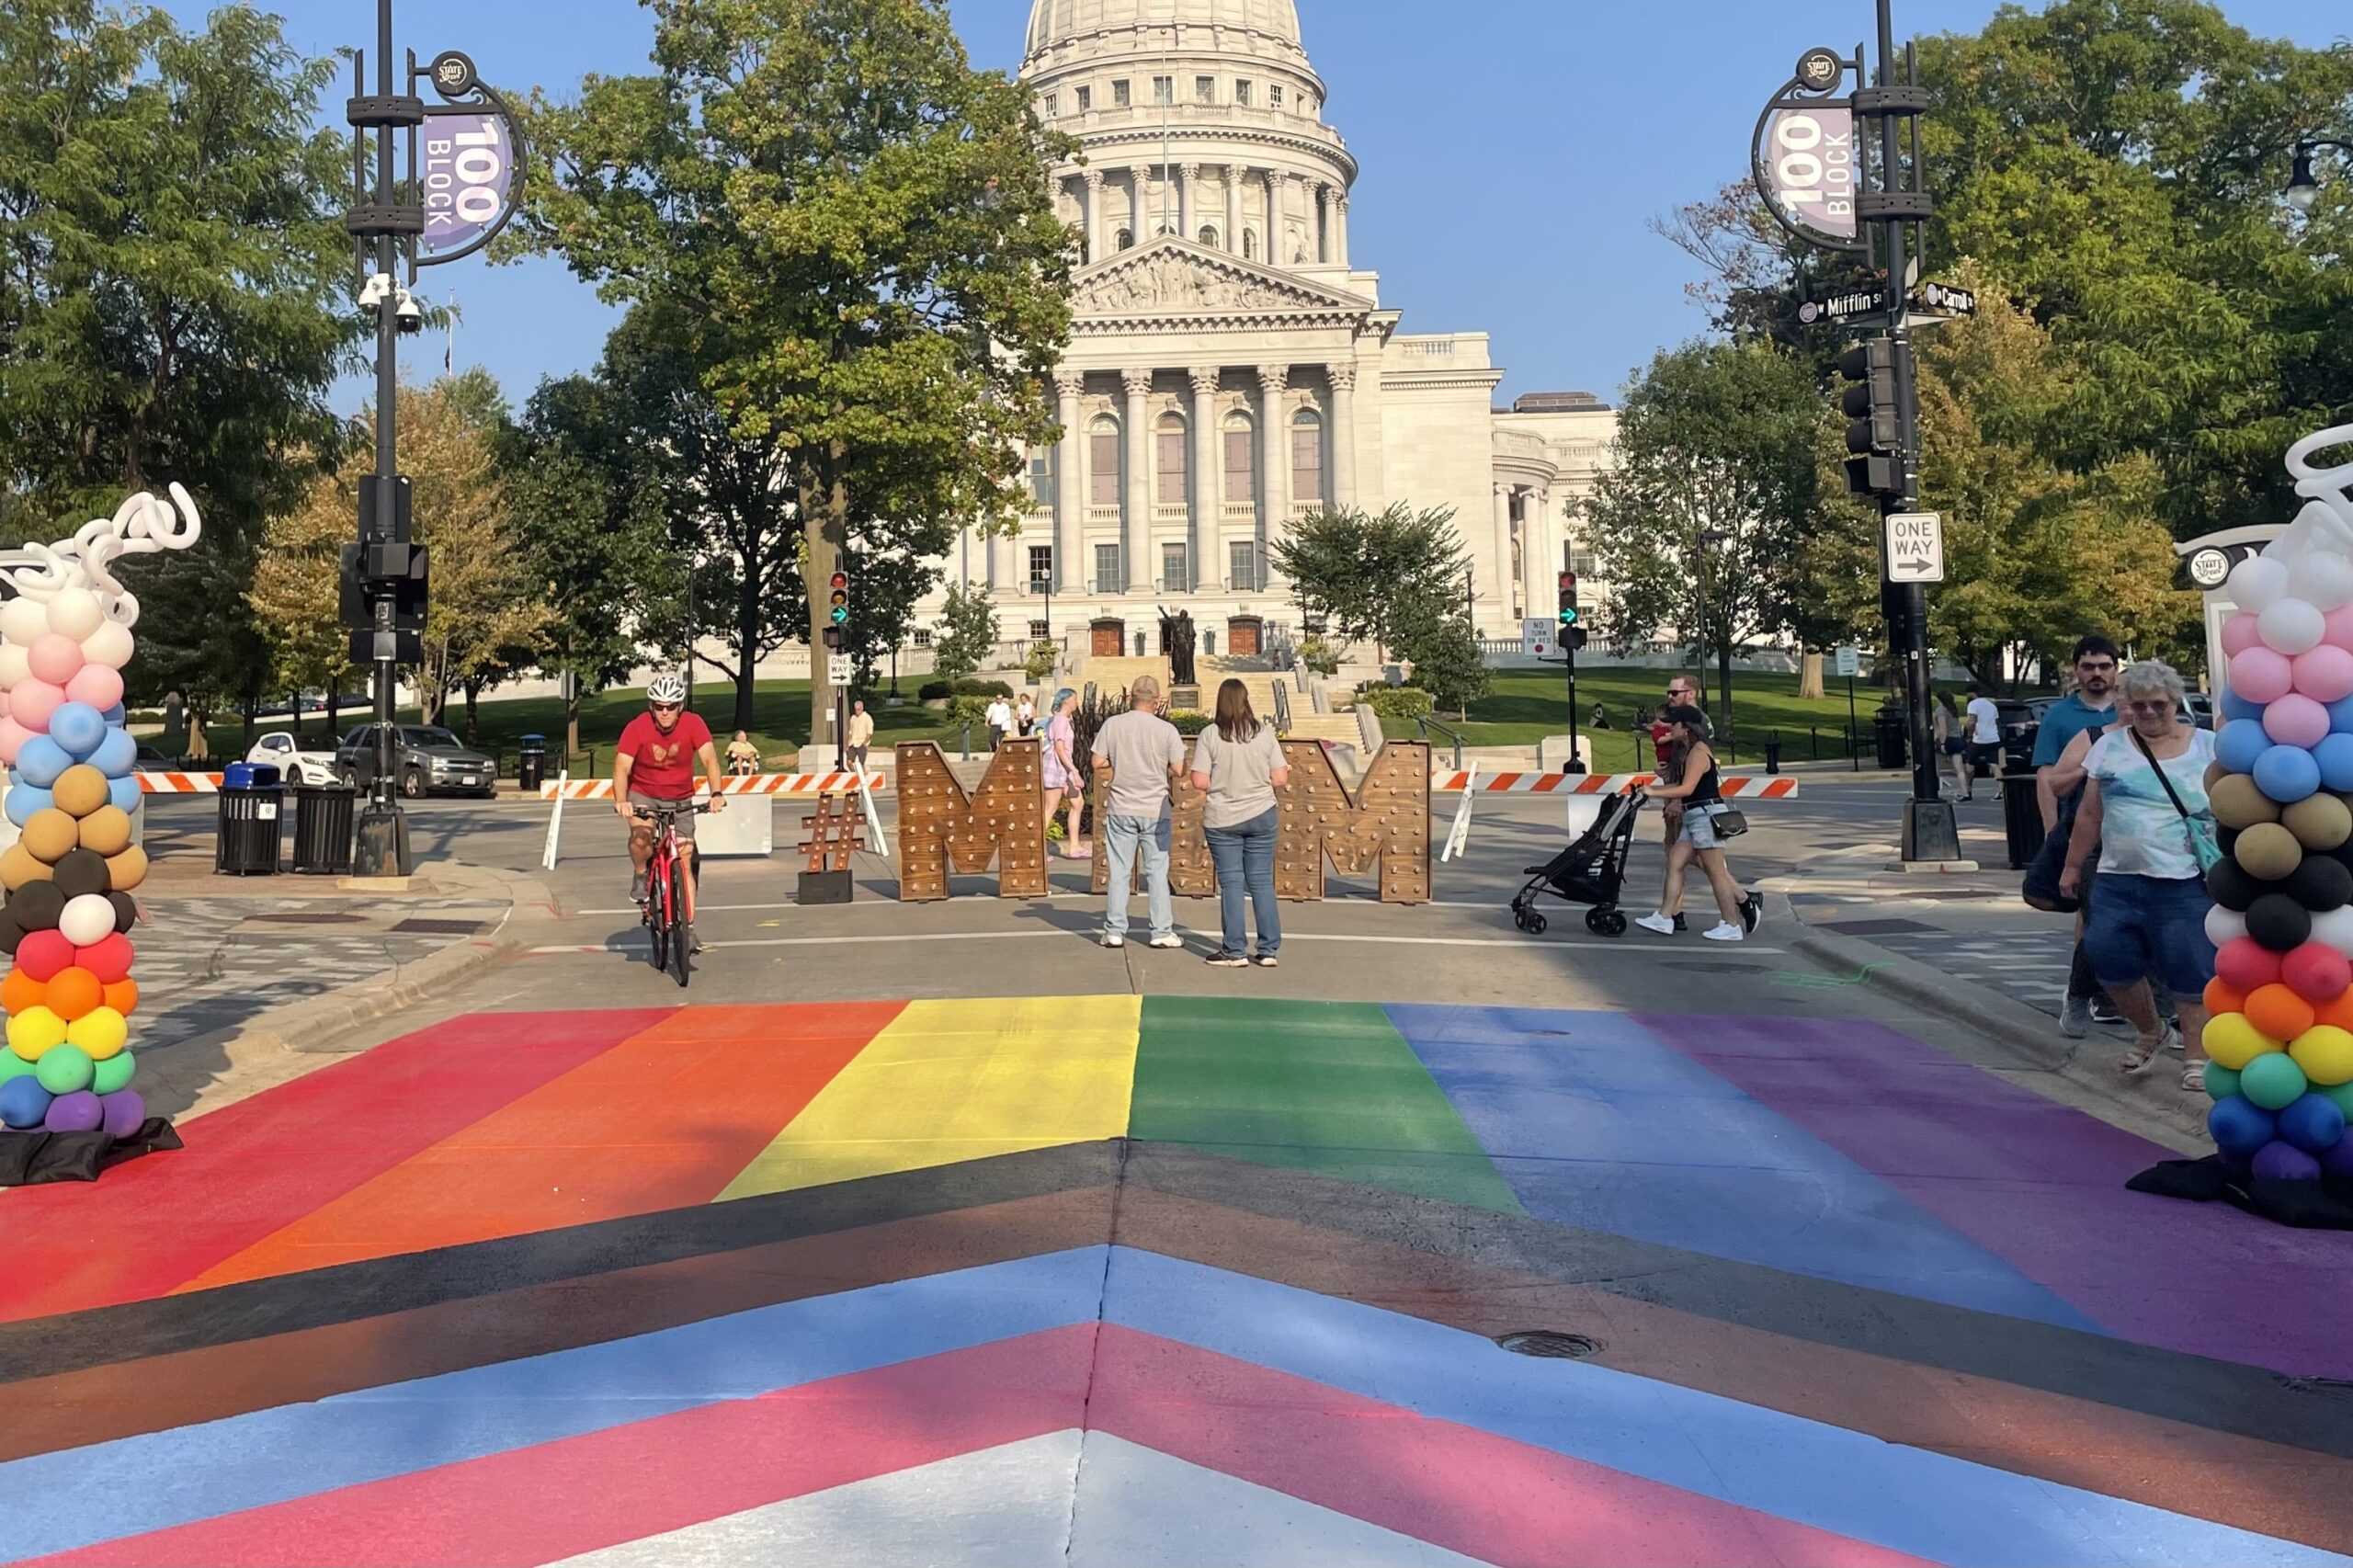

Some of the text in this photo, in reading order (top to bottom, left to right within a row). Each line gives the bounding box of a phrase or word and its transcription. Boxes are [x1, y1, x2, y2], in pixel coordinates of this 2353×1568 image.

[455, 122, 500, 222] 100
[1778, 116, 1823, 211] 100
[1825, 133, 1851, 215] BLOCK
[427, 140, 452, 225] BLOCK
[1818, 303, 1824, 313] W
[1827, 293, 1870, 316] Mifflin
[1873, 292, 1882, 303] St
[1942, 287, 1967, 310] Carroll
[1896, 522, 1931, 537] ONE
[1895, 540, 1933, 554] WAY
[2195, 559, 2222, 571] STATE
[831, 657, 847, 665] ONE
[831, 665, 848, 674] WAY
